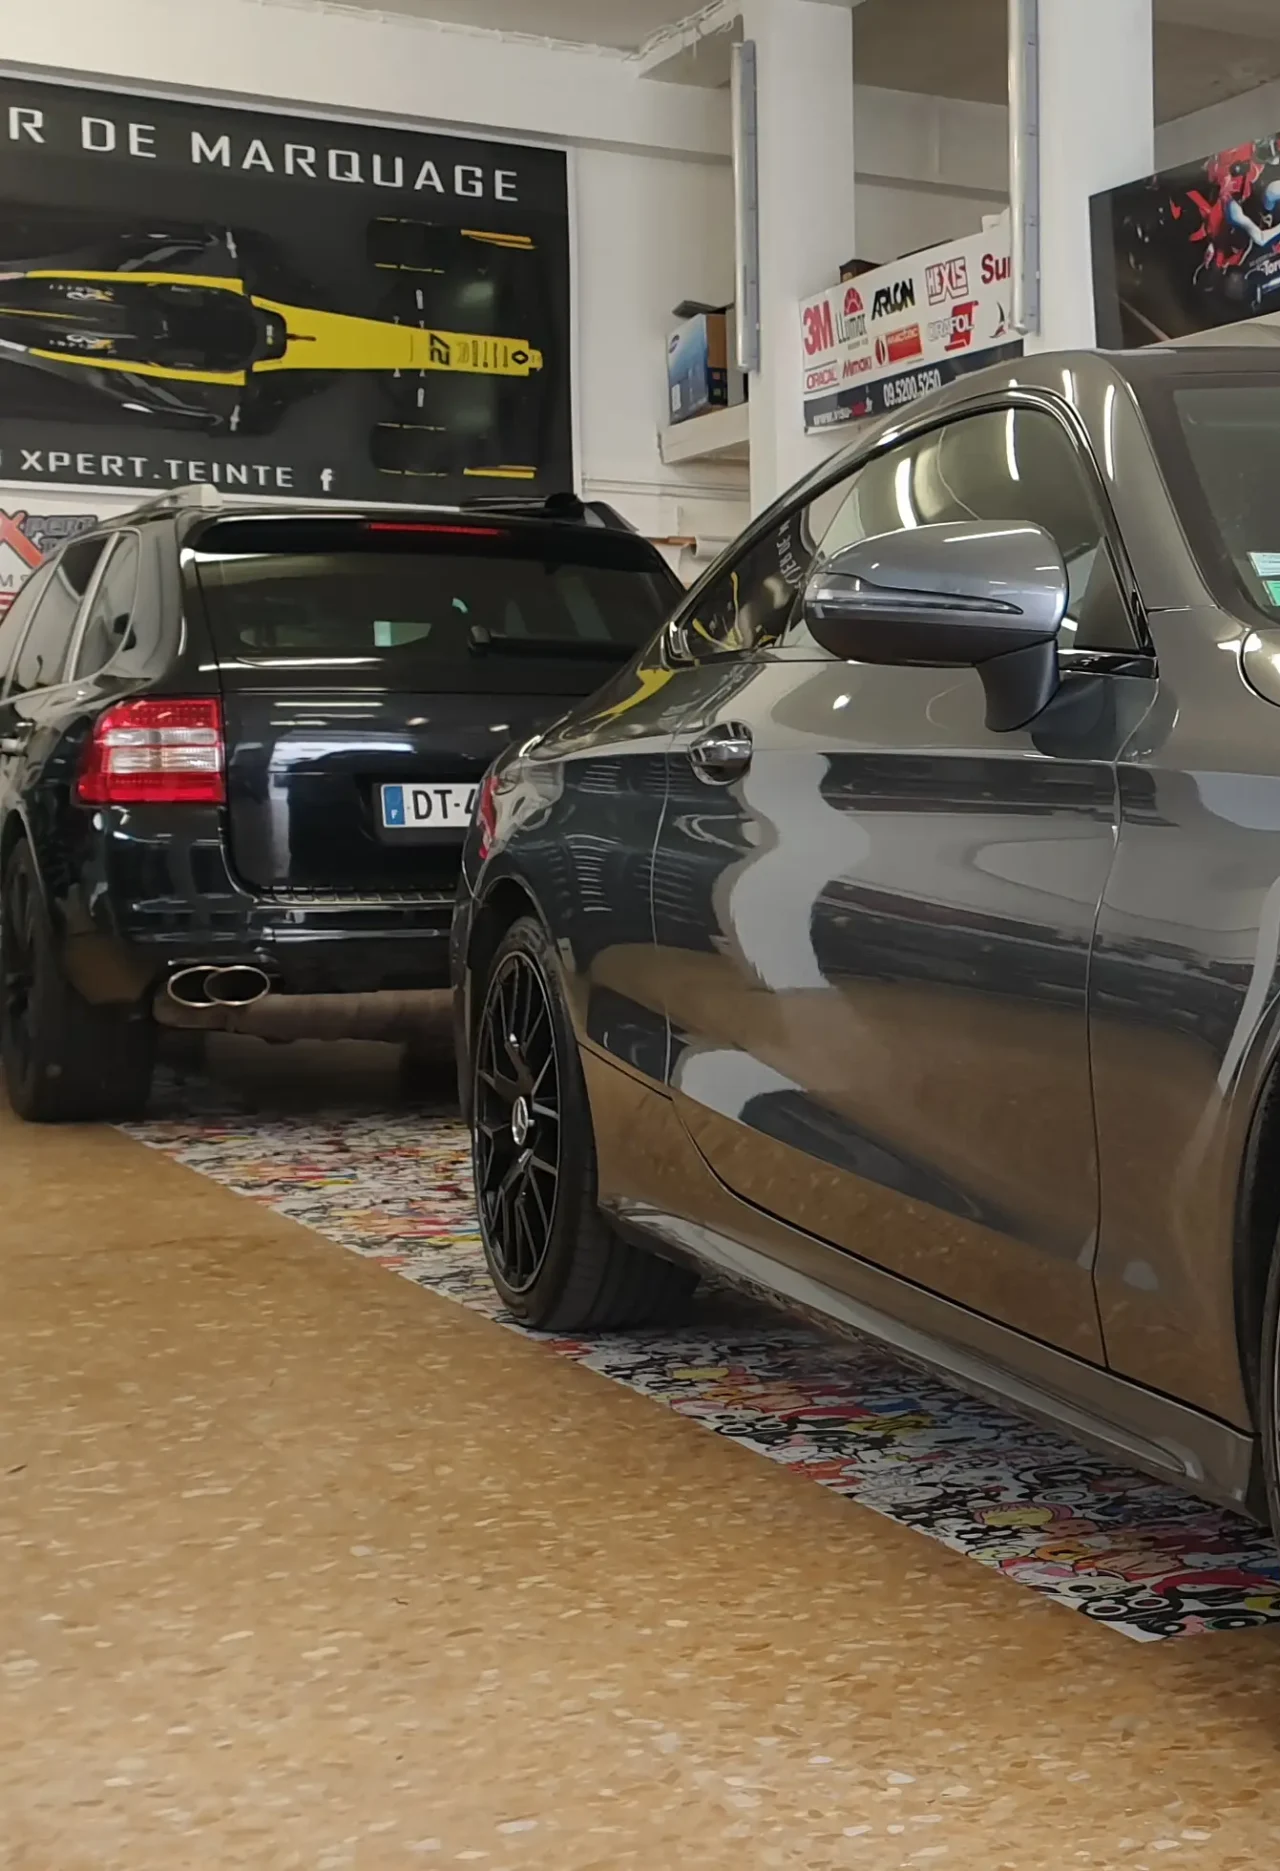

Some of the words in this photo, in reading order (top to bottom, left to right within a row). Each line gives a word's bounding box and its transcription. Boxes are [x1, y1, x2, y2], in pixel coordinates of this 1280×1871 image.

[81, 116, 157, 158] DE
[191, 131, 518, 202] MARQUAGE
[803, 300, 834, 355] 3M
[871, 278, 915, 320] ARLON
[925, 256, 969, 306] HEXIS
[926, 308, 976, 342] ORAFOL
[429, 333, 450, 366] 27
[882, 367, 942, 408] 09.5200.5250
[20, 449, 294, 488] XPERT.TEINTE
